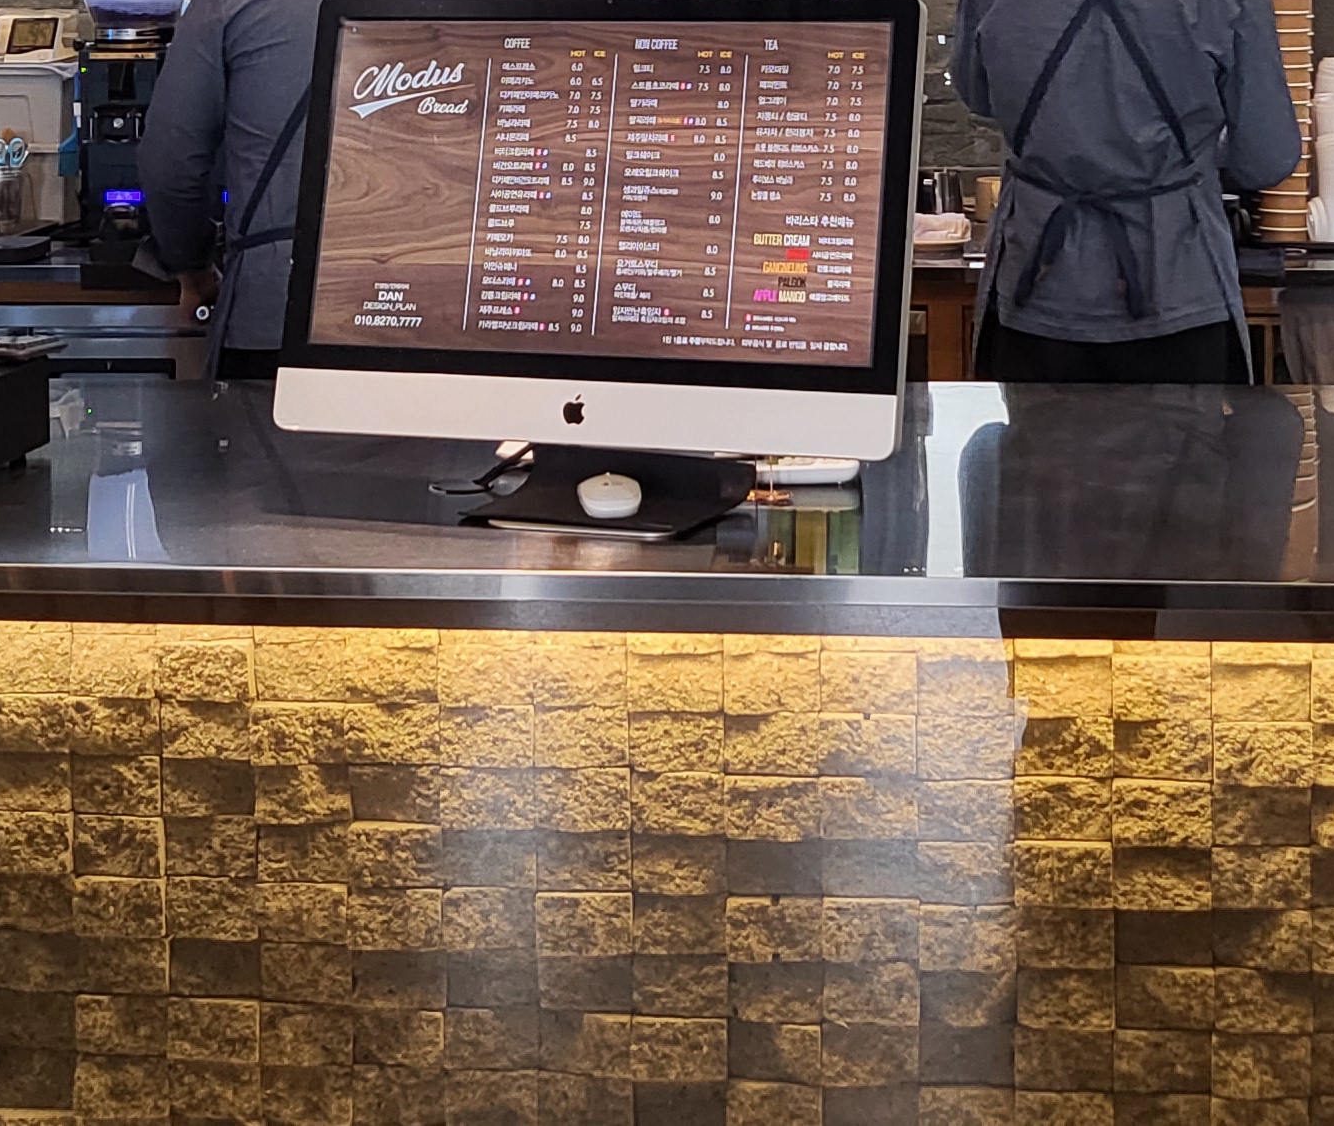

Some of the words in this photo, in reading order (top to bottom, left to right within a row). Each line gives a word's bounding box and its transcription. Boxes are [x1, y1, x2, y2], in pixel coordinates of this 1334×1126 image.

[504, 38, 530, 48] COFFEE
[651, 39, 678, 49] COFFEE
[764, 39, 779, 51] TEA
[354, 60, 465, 99] Modus
[417, 97, 468, 114] Bread
[786, 215, 818, 226] 바리스타
[820, 216, 855, 227] 추천메뉴
[753, 233, 782, 245] BUTTER
[784, 234, 810, 247] CREAM
[378, 291, 403, 301] DAN
[778, 290, 806, 302] MANGO
